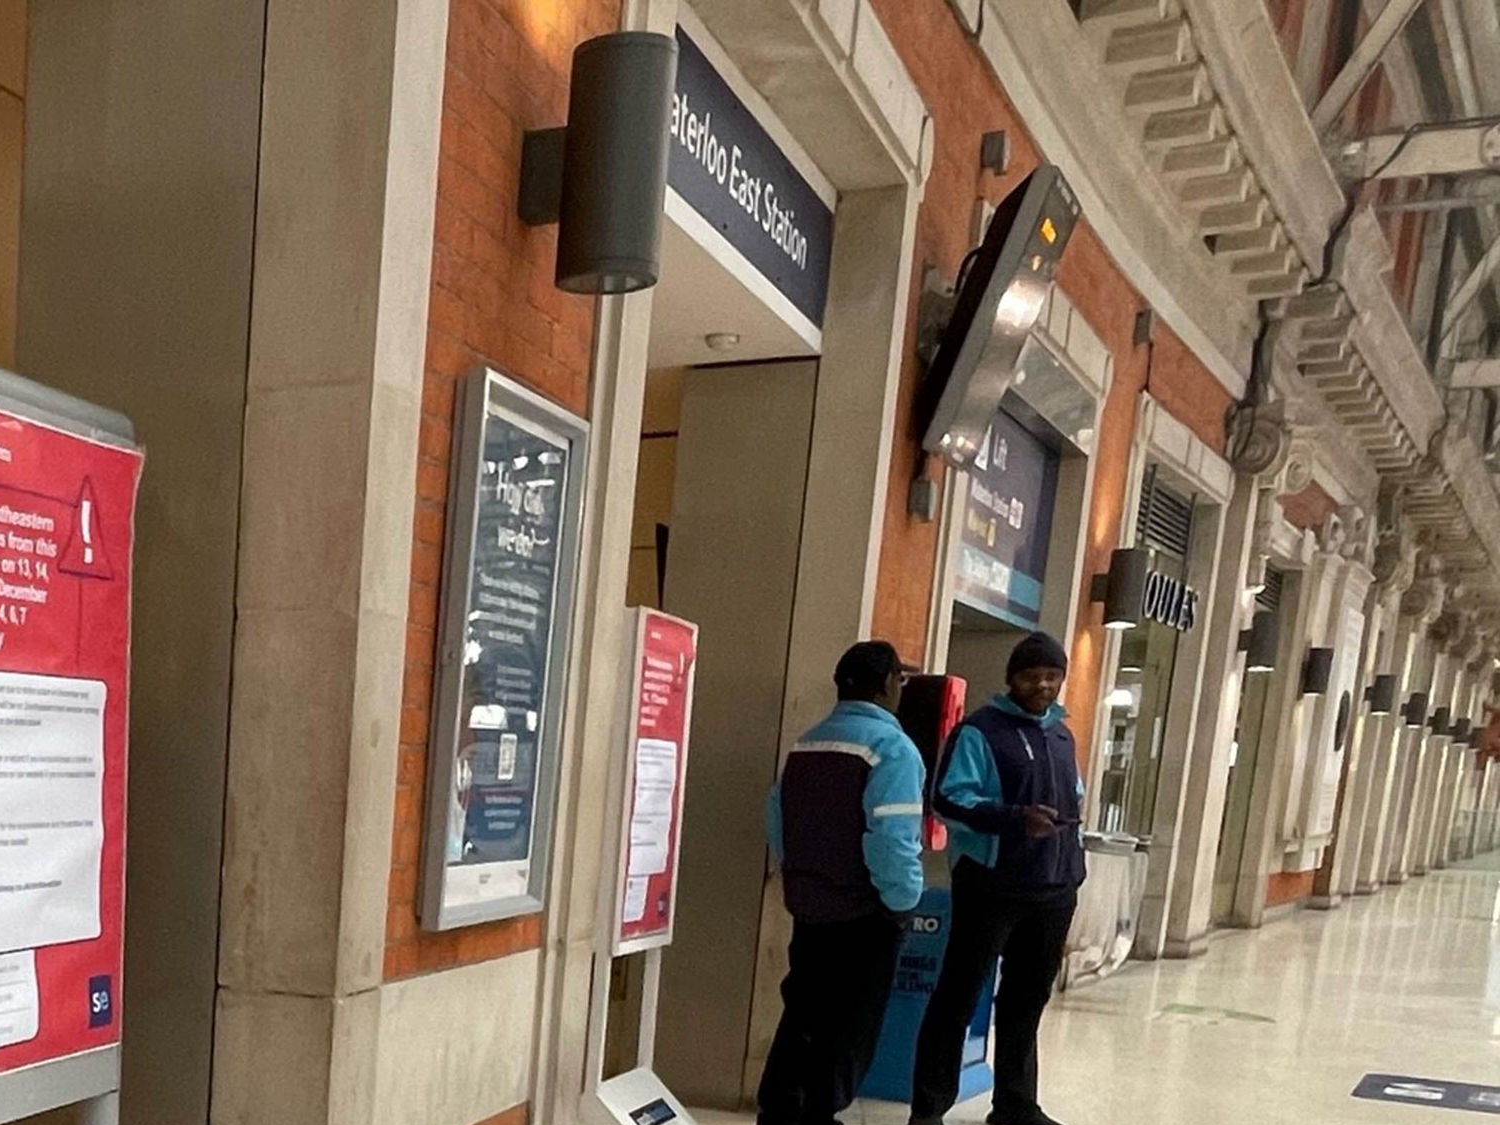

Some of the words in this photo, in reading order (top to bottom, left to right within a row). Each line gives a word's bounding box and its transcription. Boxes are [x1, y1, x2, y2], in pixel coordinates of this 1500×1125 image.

[671, 91, 727, 185] aterloo
[729, 144, 761, 222] East
[762, 183, 808, 271] Station
[2, 557, 15, 571] on
[8, 531, 33, 552] from
[36, 539, 57, 558] this
[1145, 571, 1198, 633] OULES
